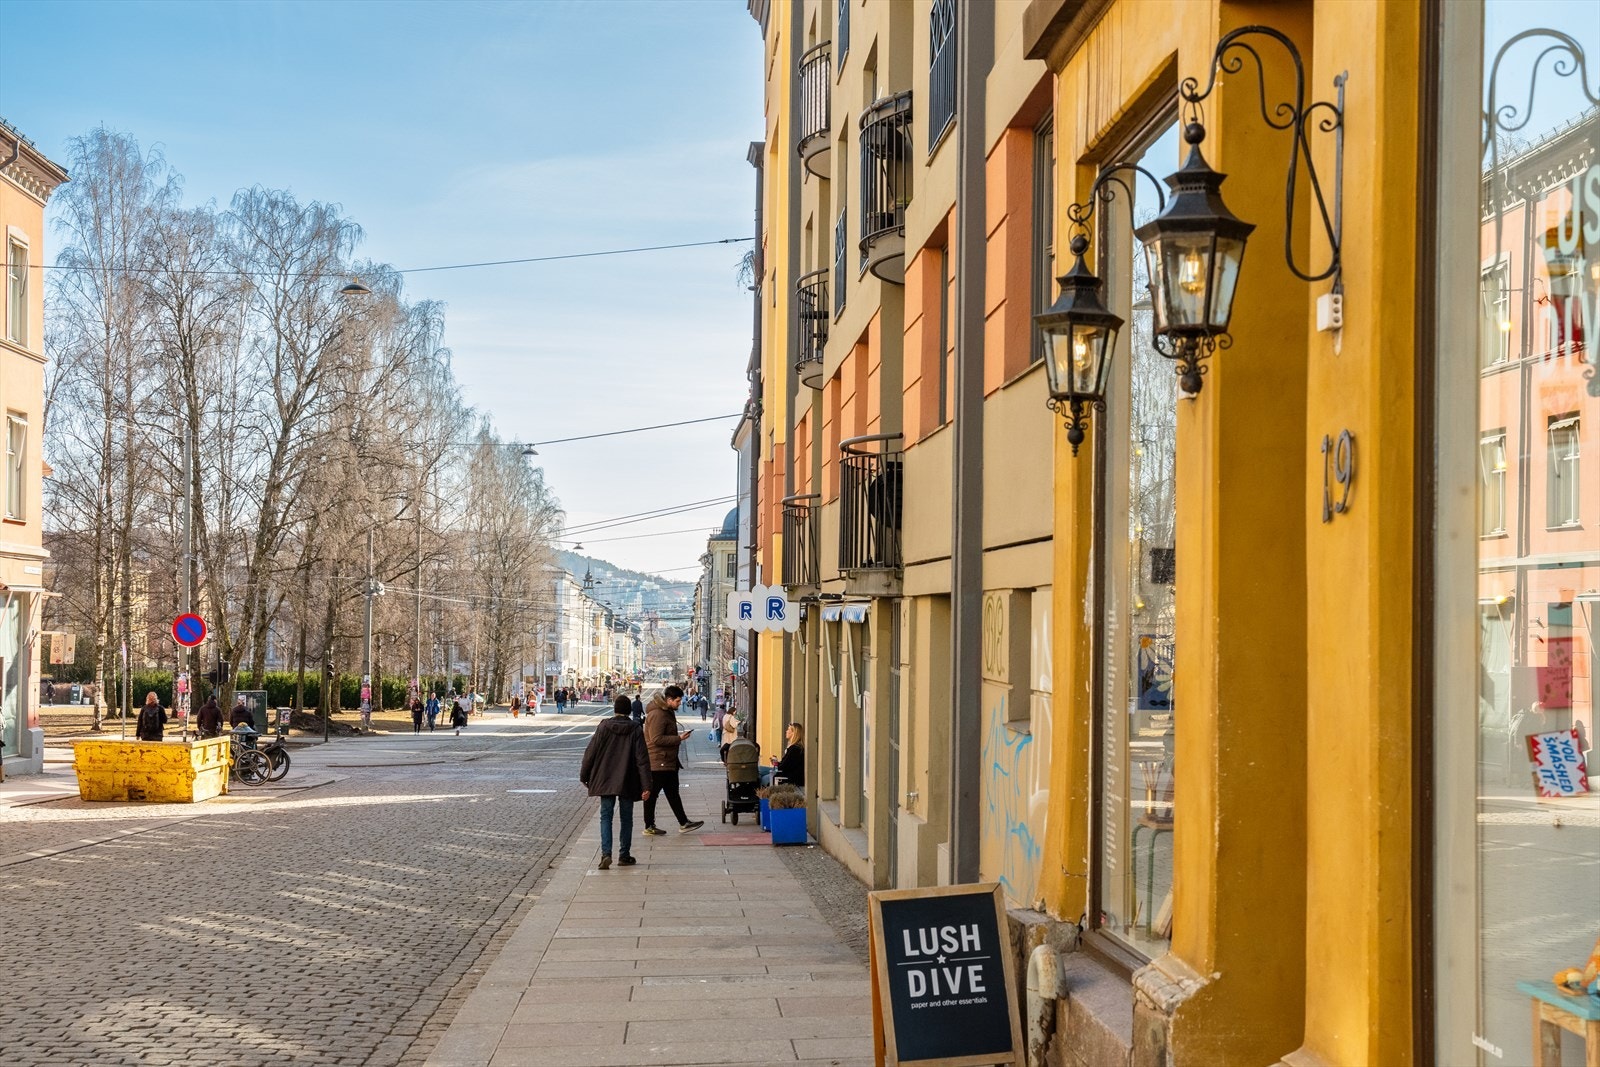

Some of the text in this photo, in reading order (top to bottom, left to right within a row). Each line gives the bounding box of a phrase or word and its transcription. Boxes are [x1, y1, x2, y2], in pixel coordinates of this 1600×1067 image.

[1321, 429, 1352, 523] 19
[739, 601, 752, 620] R
[766, 596, 785, 621] R
[1543, 737, 1574, 793] SMASHED
[1559, 740, 1577, 763] YOU
[1540, 769, 1558, 787] IT!
[902, 924, 981, 957] LUSH
[907, 965, 986, 998] DIVE
